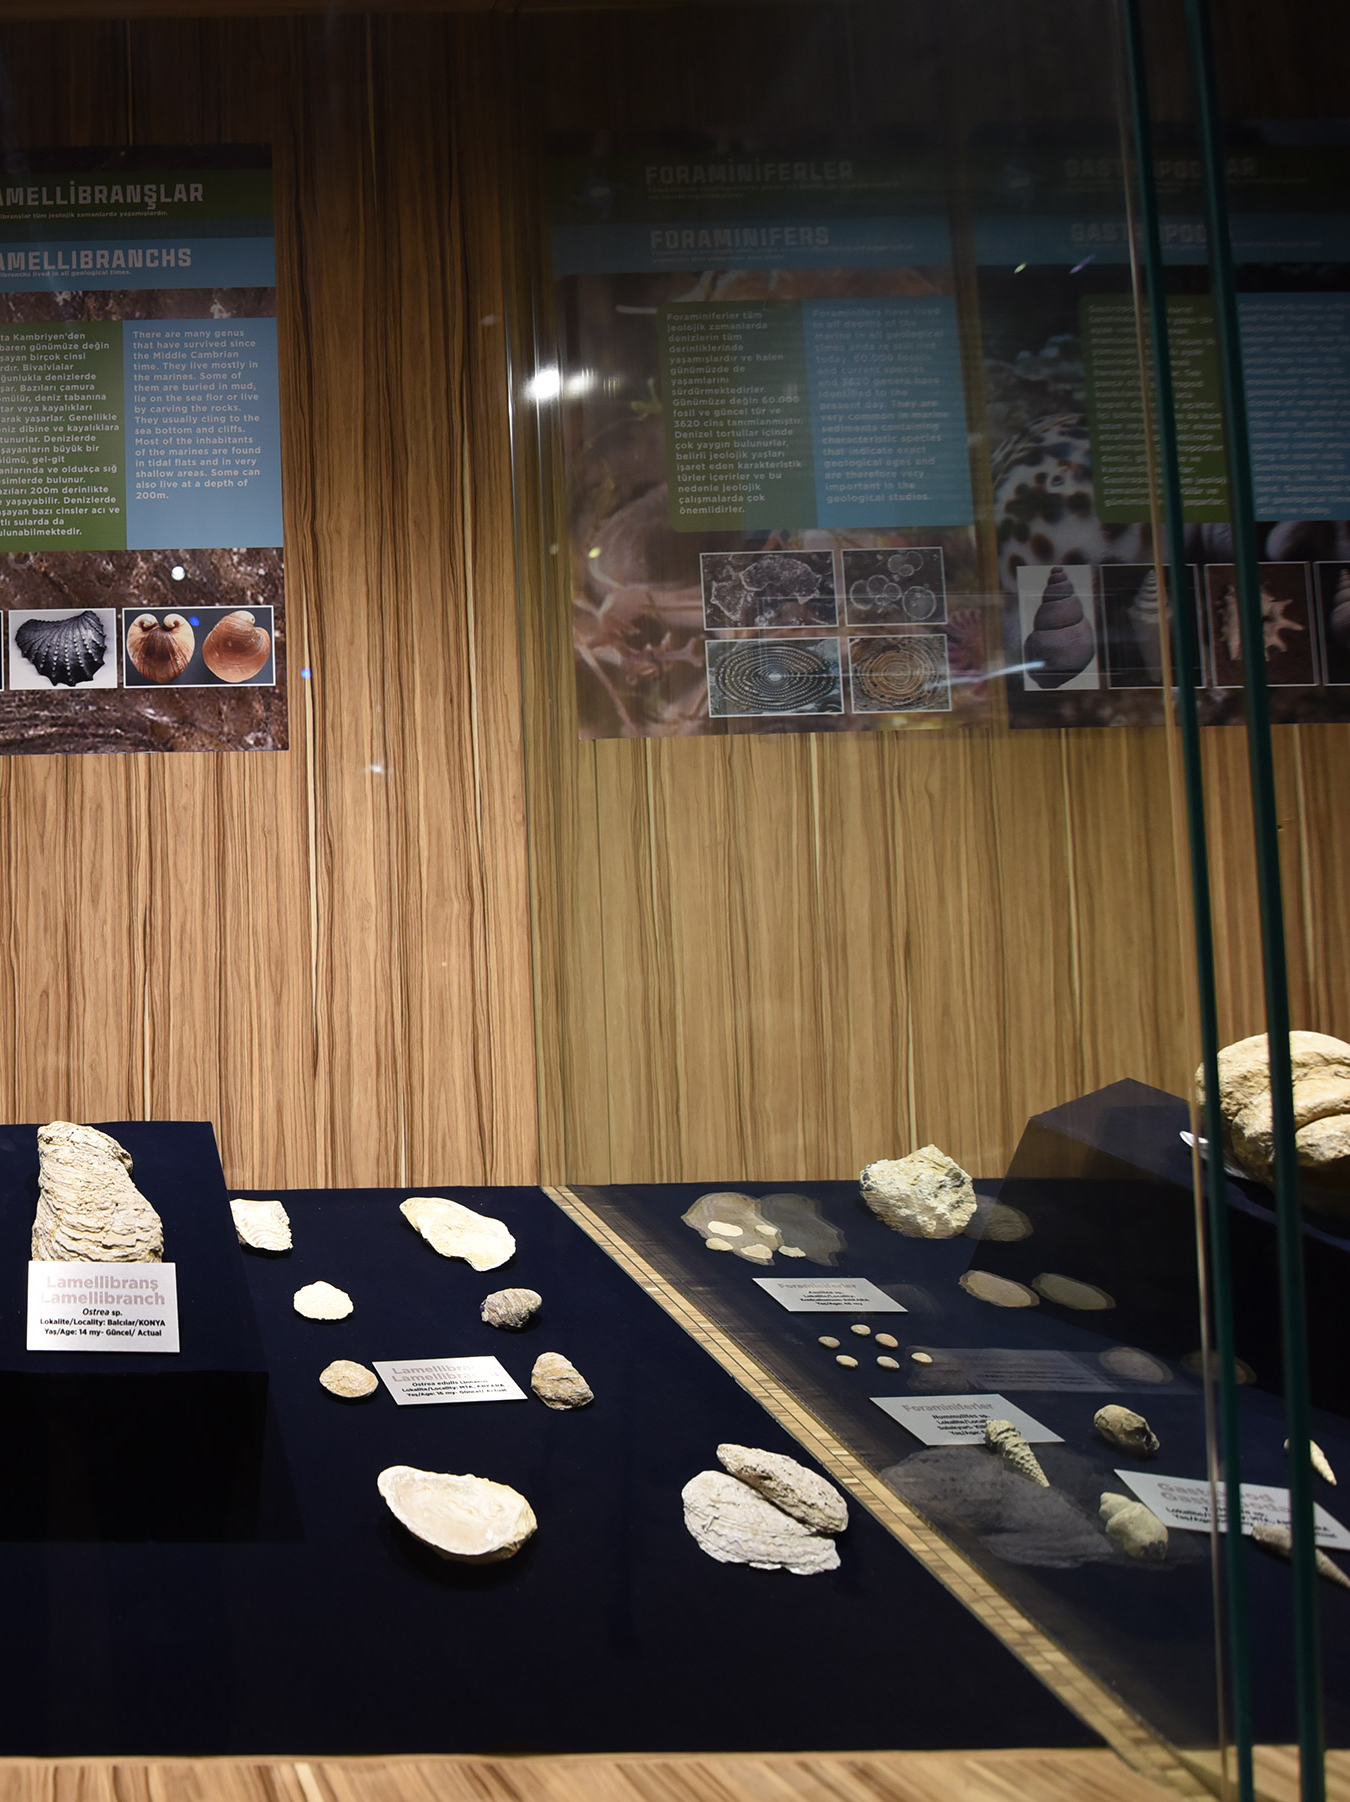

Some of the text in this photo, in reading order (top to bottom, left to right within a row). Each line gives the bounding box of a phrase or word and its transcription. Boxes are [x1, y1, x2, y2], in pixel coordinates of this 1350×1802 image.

[650, 226, 830, 249] FORAMINIFERS
[13, 332, 85, 341] Kambriyen'den
[132, 330, 161, 338] There
[184, 330, 210, 338] many
[214, 330, 244, 338] genus
[29, 342, 79, 352] günümüze
[81, 341, 109, 350] değin
[133, 339, 255, 349] that have survived since
[153, 351, 187, 359] Middle
[190, 350, 238, 358] Cambrian
[22, 362, 73, 371] Bivalvialar
[44, 372, 96, 380] denizlerde
[133, 373, 149, 381] the
[153, 372, 196, 380] marines.
[230, 371, 241, 379] of
[34, 393, 61, 401] deniz
[64, 393, 106, 401] tabanına
[24, 414, 65, 423] yaşarlar.
[68, 413, 117, 421] Genellikle
[154, 426, 192, 434] bottom
[195, 425, 214, 433] and
[217, 424, 245, 433] cliffs.
[43, 434, 96, 442] Denizlerde
[135, 435, 253, 445] Most of the inhabitants
[32, 455, 64, 464] gel-git
[46, 475, 85, 483] bulunur.
[30, 486, 58, 494] 200m
[61, 485, 108, 493] derinlikte
[135, 491, 168, 499] 200m.
[13, 517, 49, 525] sularda
[52, 517, 64, 525] da
[46, 1276, 159, 1292] Lamellibranş
[41, 1291, 165, 1306] Lamellibranch
[82, 1307, 110, 1316] Ostrea
[40, 1318, 166, 1327] Lokalite/Locality: Balcılar/KONYA
[44, 1328, 77, 1336] Yaş/Age:
